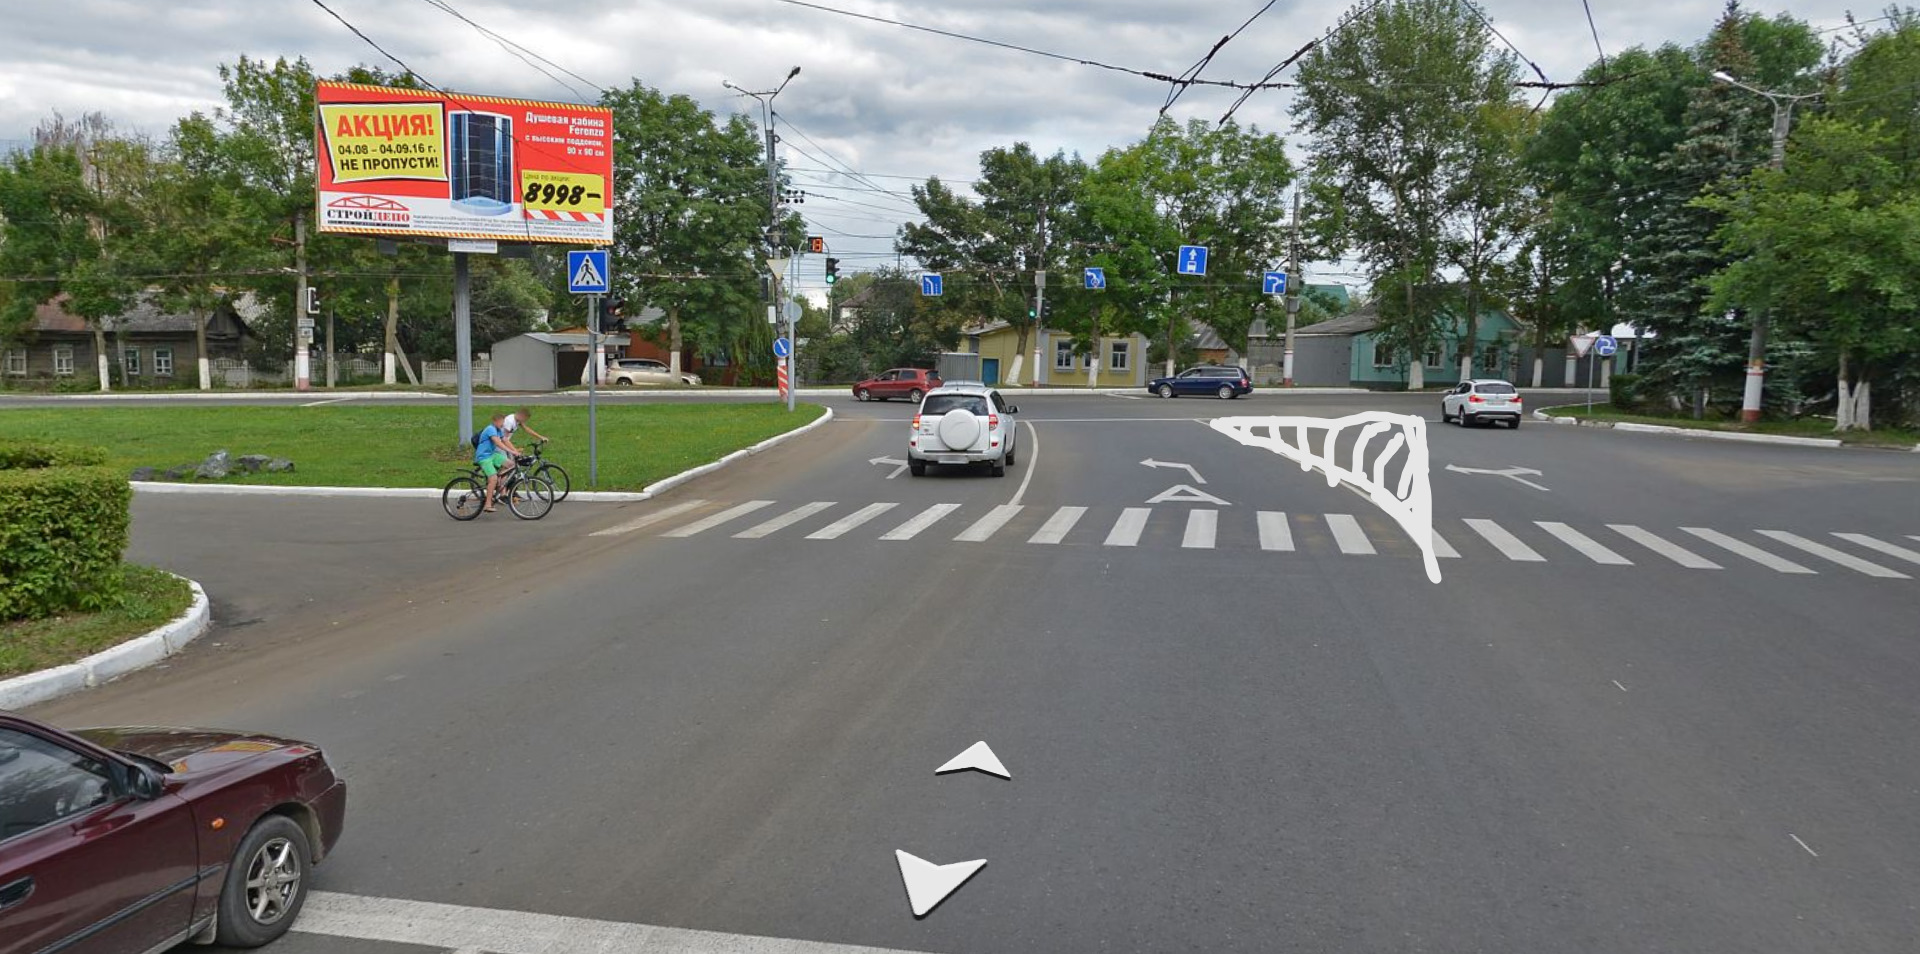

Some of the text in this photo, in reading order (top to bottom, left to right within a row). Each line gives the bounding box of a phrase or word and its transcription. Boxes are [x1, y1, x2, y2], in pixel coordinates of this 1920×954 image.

[525, 111, 604, 127] Душевая кабина
[337, 114, 434, 141] АКЦИЯ!
[338, 145, 369, 155] 04.08
[379, 143, 425, 154] 04.09.16
[427, 144, 436, 153] г.
[340, 157, 439, 171] НЕ ПРОПУСТИ!
[327, 209, 410, 222] СТРОЙДЕПО
